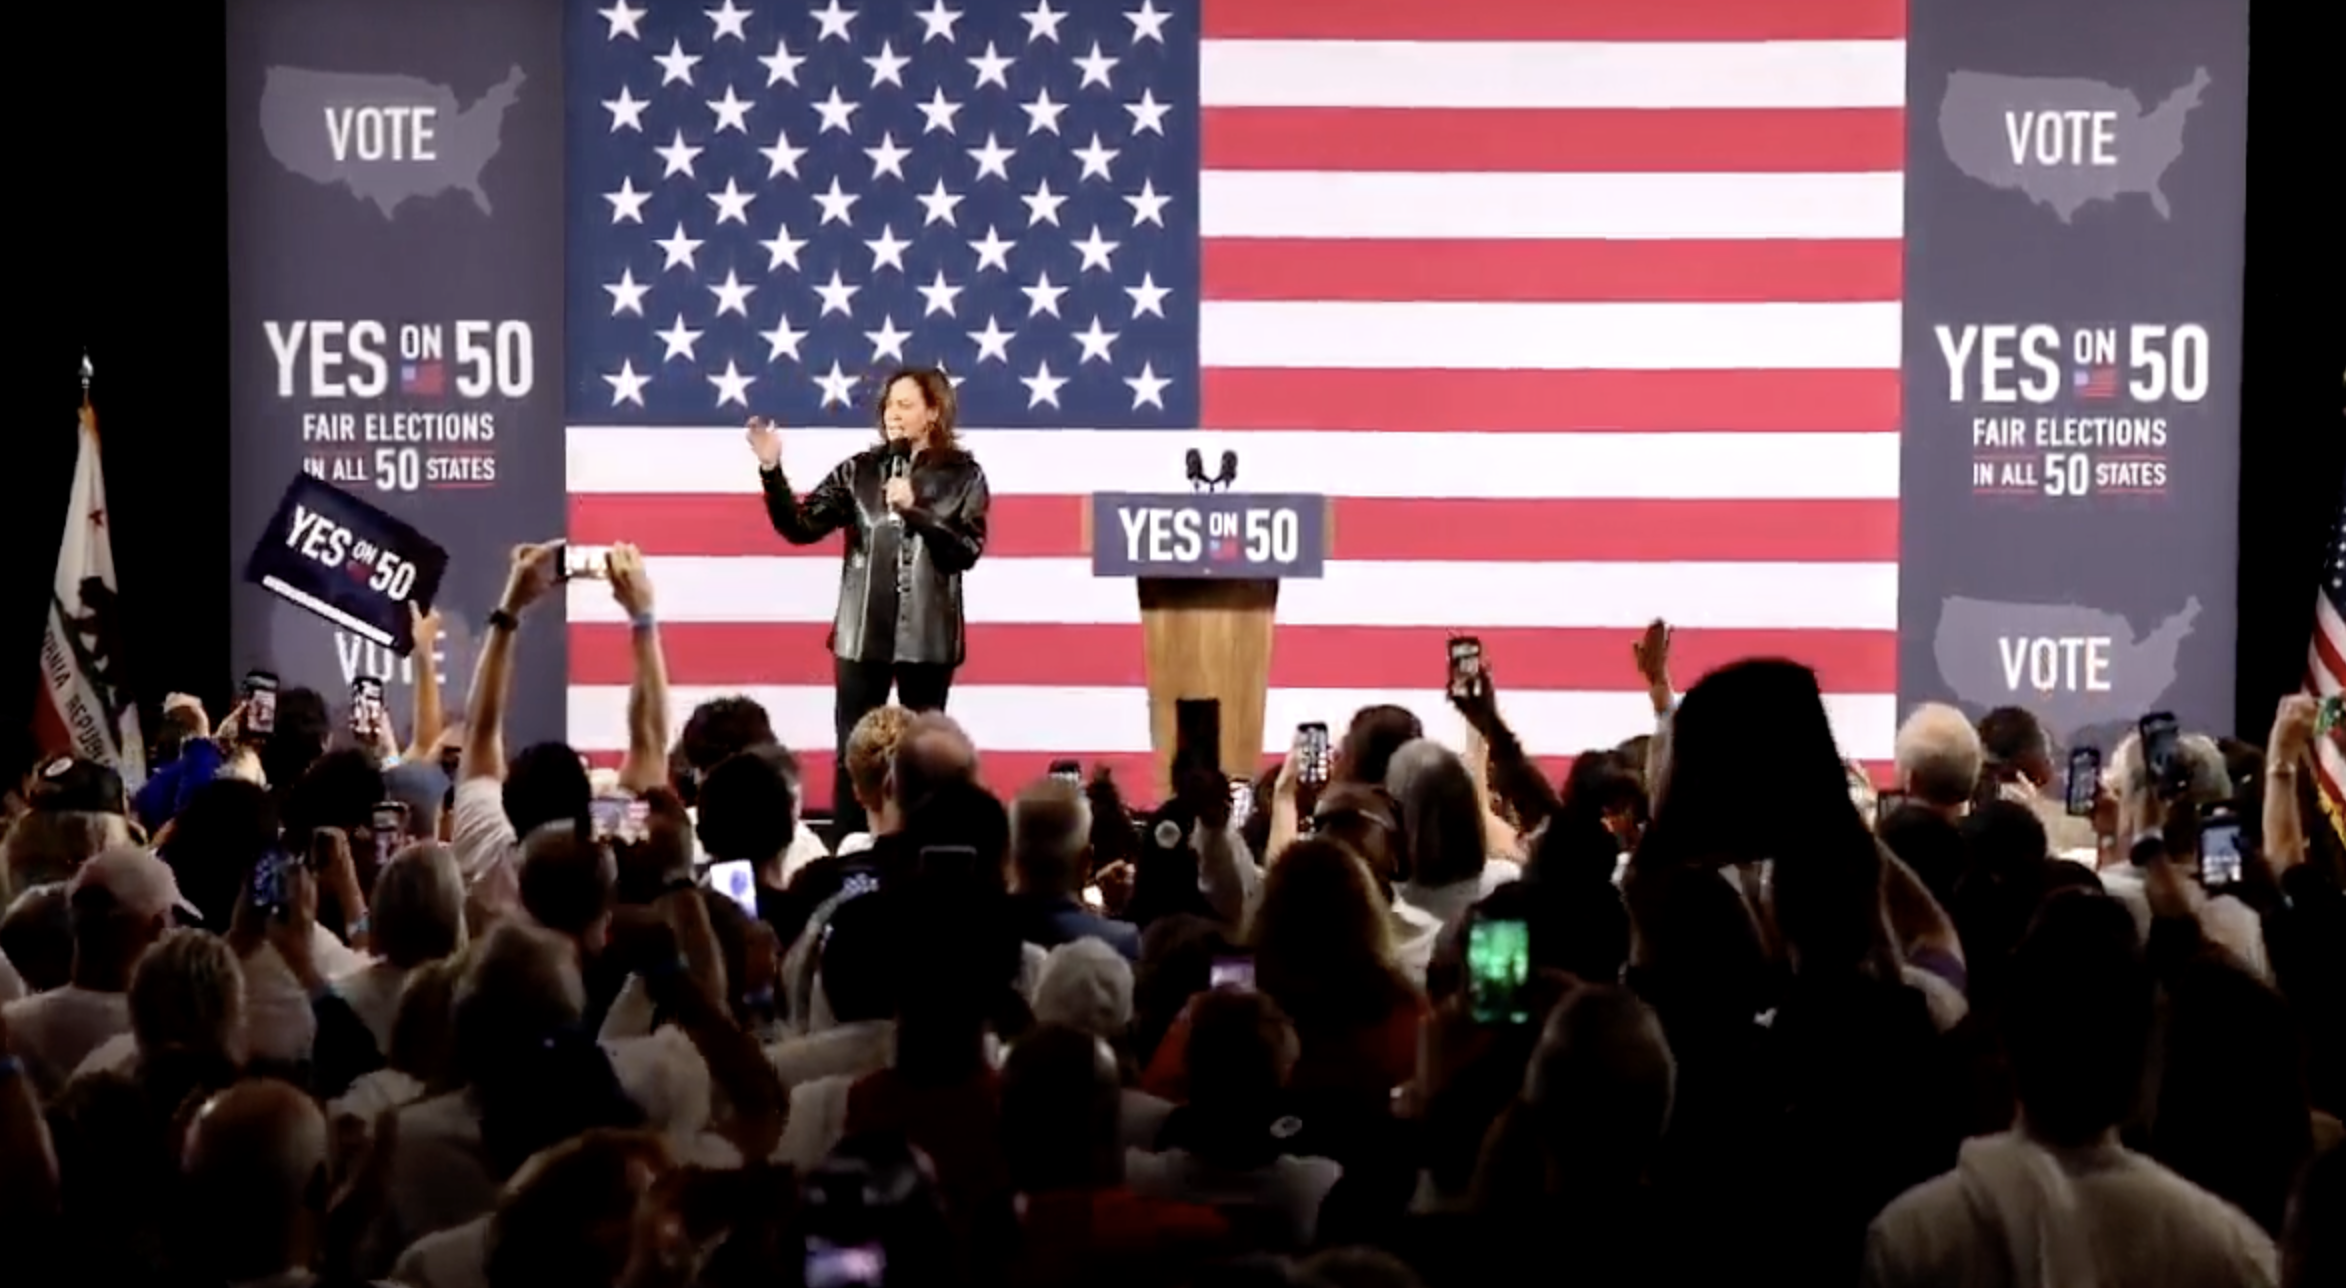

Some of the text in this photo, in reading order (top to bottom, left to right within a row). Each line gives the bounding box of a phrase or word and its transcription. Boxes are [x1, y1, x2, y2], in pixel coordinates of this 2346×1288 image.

[325, 106, 436, 161] VOTE
[2005, 110, 2117, 165] VOTE
[263, 320, 533, 398] YES ON 50
[1934, 323, 2209, 403] YES ON 50
[303, 413, 495, 442] FAIR ELECTIONS
[1973, 418, 2167, 447] FAIR ELECTIONS
[332, 457, 368, 481] ALL
[375, 447, 420, 491] 50
[426, 457, 496, 481] STATES
[1973, 453, 2167, 497] IN ALL 50 STATES
[286, 503, 417, 601] YES ON 50
[1118, 507, 1299, 563] YES ON 50
[1999, 636, 2112, 691] VOTE
